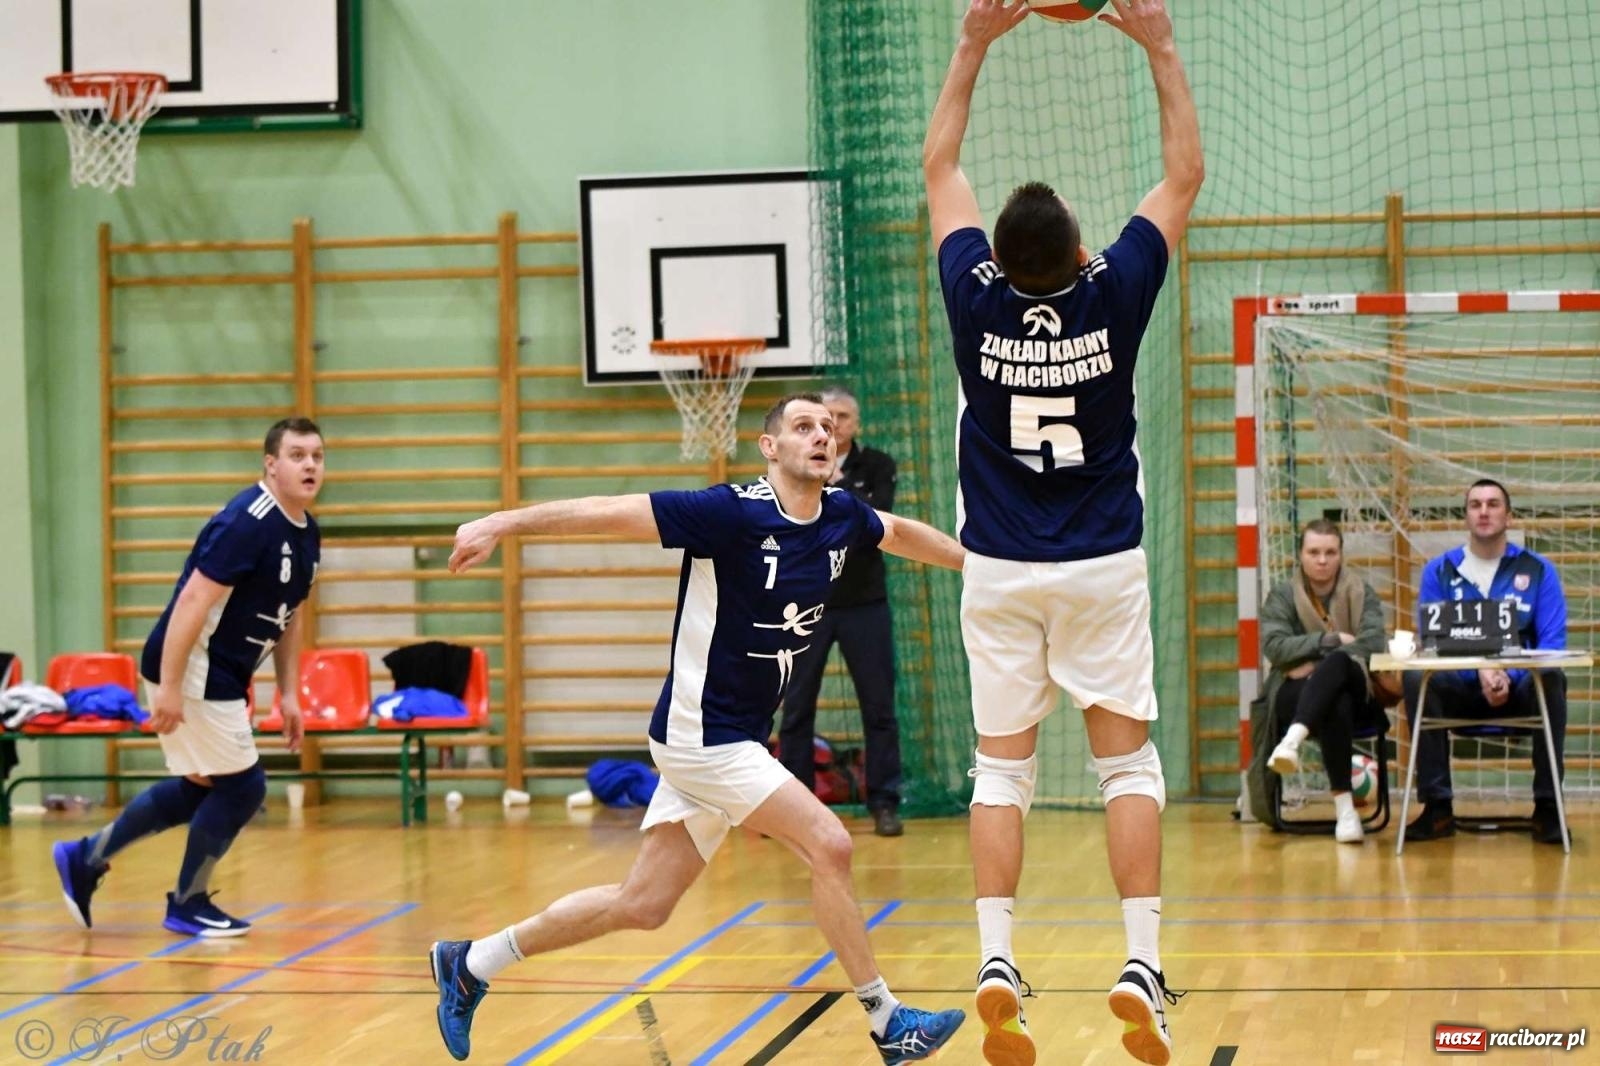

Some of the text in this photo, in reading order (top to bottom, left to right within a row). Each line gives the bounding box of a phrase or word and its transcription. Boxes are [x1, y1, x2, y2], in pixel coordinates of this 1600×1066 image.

[1309, 300, 1339, 311] sport
[979, 328, 1110, 363] ZAKŁAD KARNY
[980, 351, 1114, 388] W RACIBORZU
[1010, 394, 1085, 474] 5
[760, 543, 781, 551] adidas
[280, 557, 291, 584] 8
[763, 555, 778, 590] 7
[1428, 603, 1441, 631] 2
[1498, 602, 1512, 630] 5
[1450, 626, 1482, 638] JOOLA
